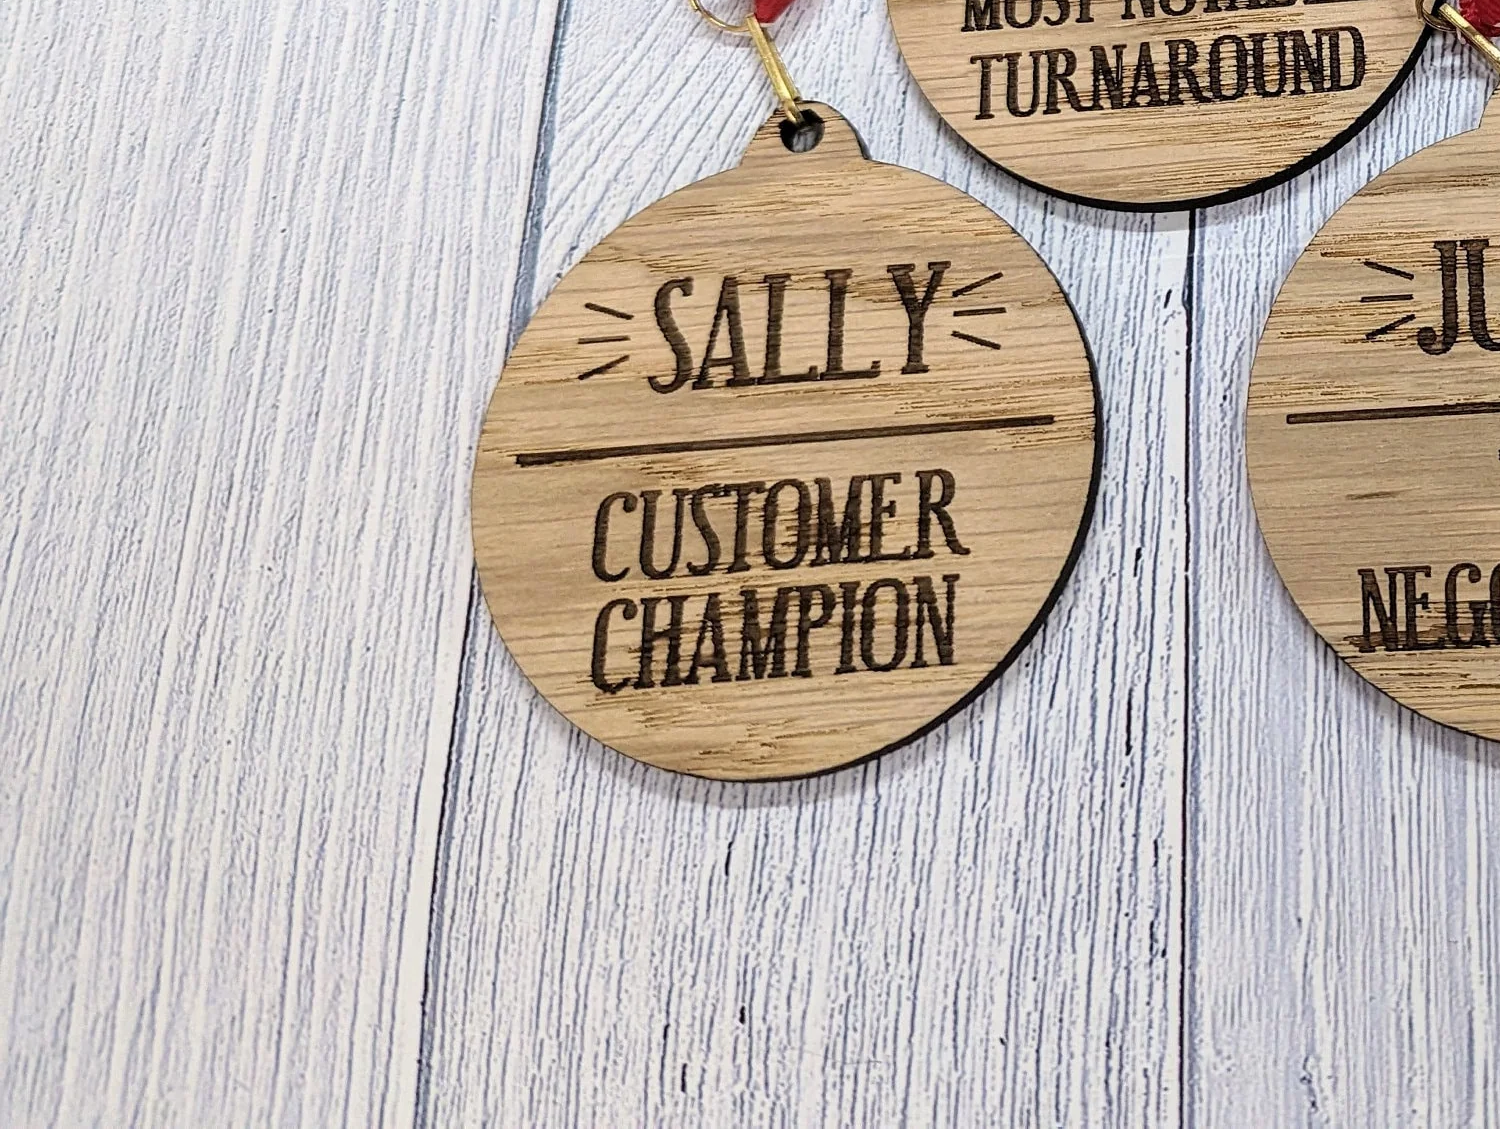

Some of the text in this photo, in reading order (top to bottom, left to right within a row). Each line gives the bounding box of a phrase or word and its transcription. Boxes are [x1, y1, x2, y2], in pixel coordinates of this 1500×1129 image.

[970, 25, 1367, 121] TURNAROUND
[648, 260, 951, 395] SALLY
[591, 468, 971, 582] CUSTOMER
[590, 573, 960, 695] CHAMPION
